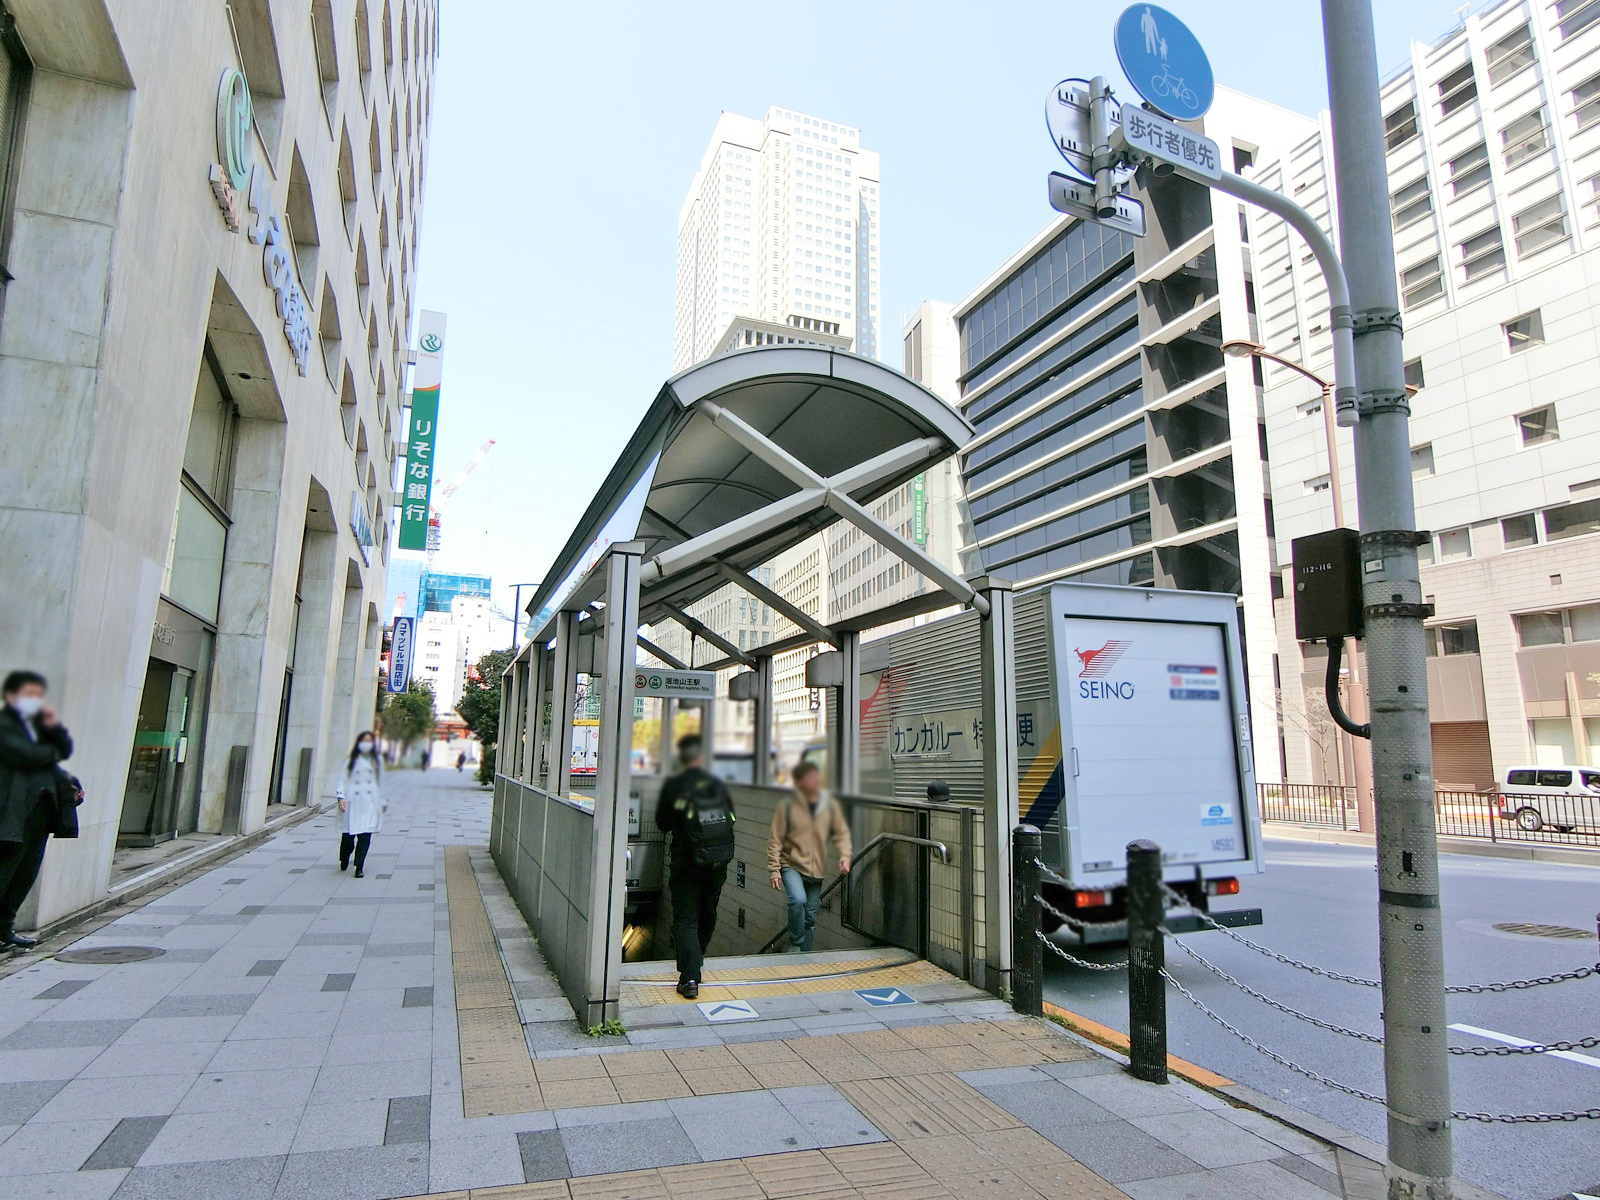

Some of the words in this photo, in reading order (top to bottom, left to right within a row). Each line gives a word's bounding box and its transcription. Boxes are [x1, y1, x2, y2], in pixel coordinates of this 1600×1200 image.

[1129, 115, 1215, 171] 歩行者優先
[405, 419, 432, 522] りそな銀行
[1079, 680, 1135, 700] SEINO
[895, 721, 963, 752] カンガルー
